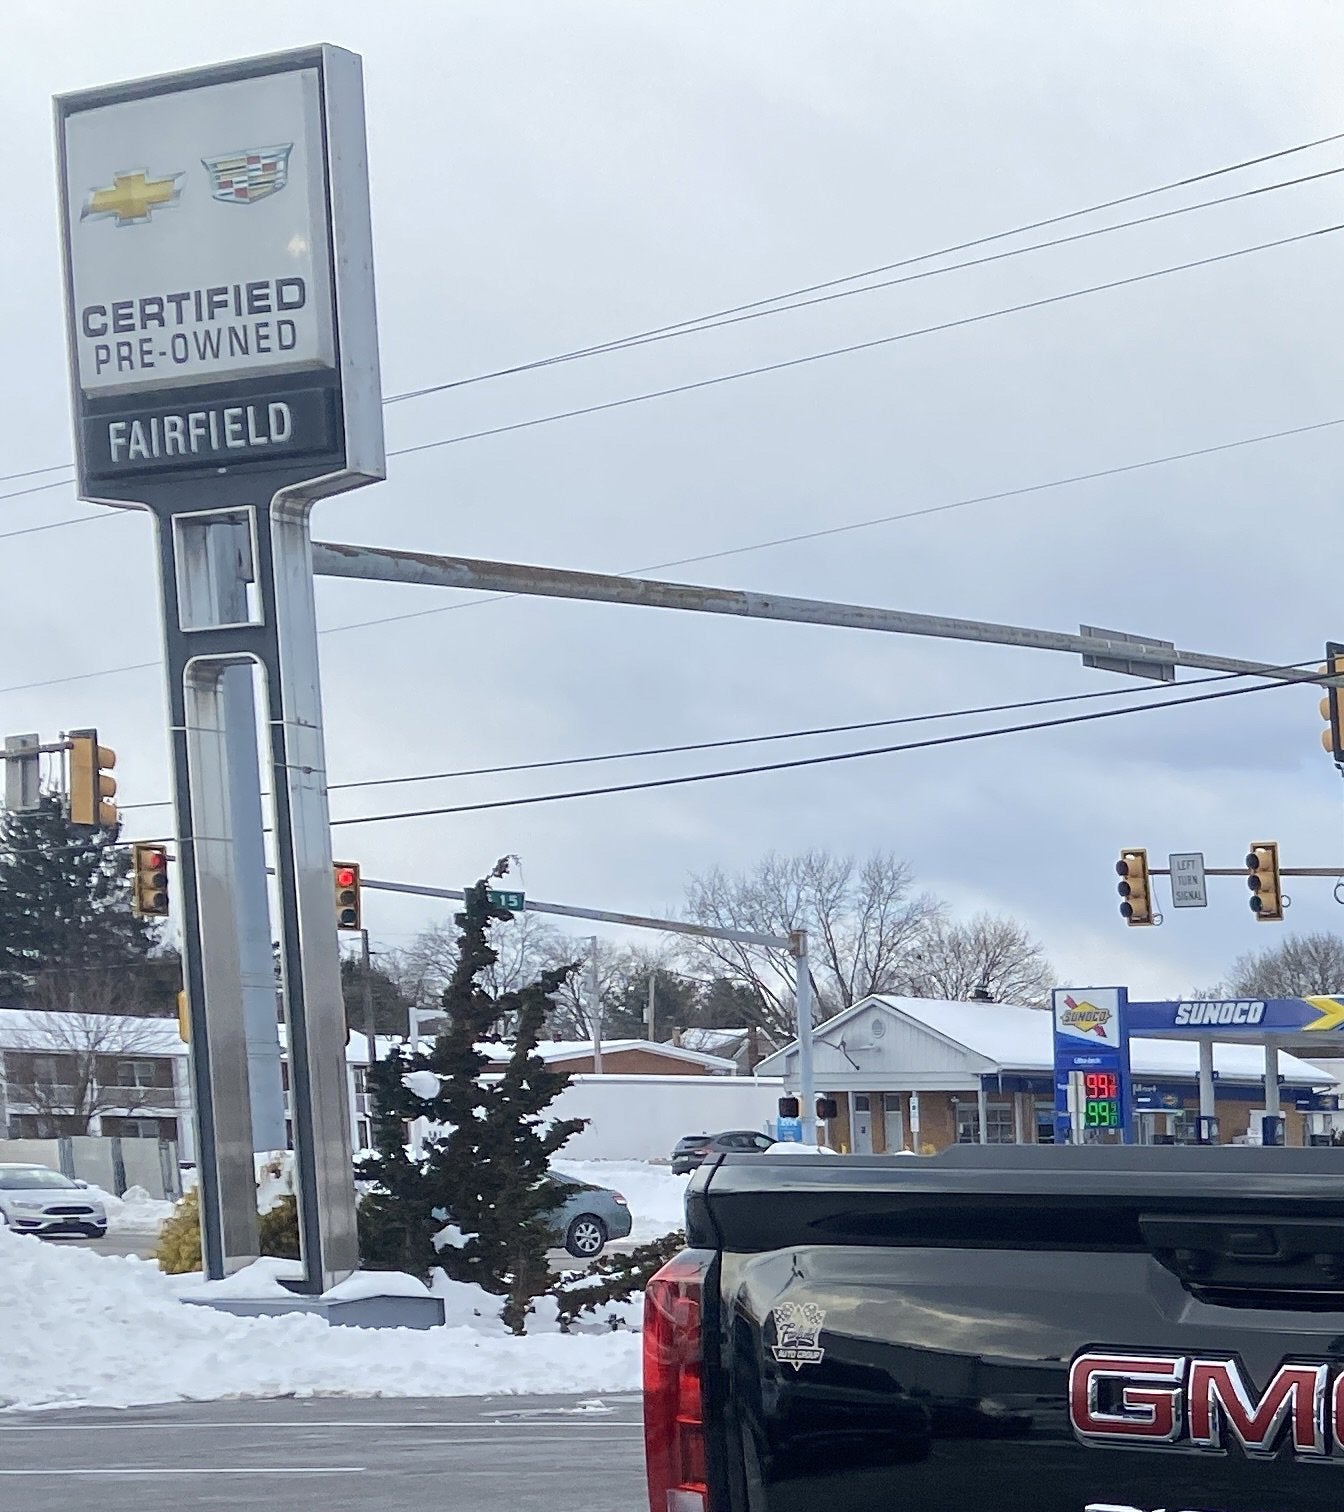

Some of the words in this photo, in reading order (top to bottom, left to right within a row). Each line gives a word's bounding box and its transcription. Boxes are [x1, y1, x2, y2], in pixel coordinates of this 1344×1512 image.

[82, 277, 306, 338] CERTIFIED
[95, 319, 296, 375] PRE-OWNED
[108, 401, 293, 463] FAIRFIELD
[1177, 860, 1195, 870] LEFT
[1177, 875, 1198, 885] TURN
[500, 894, 518, 907] 15
[1176, 890, 1203, 901] SIGNAL
[1063, 1009, 1108, 1023] SUNOCO
[1175, 1002, 1265, 1025] SUNOCO
